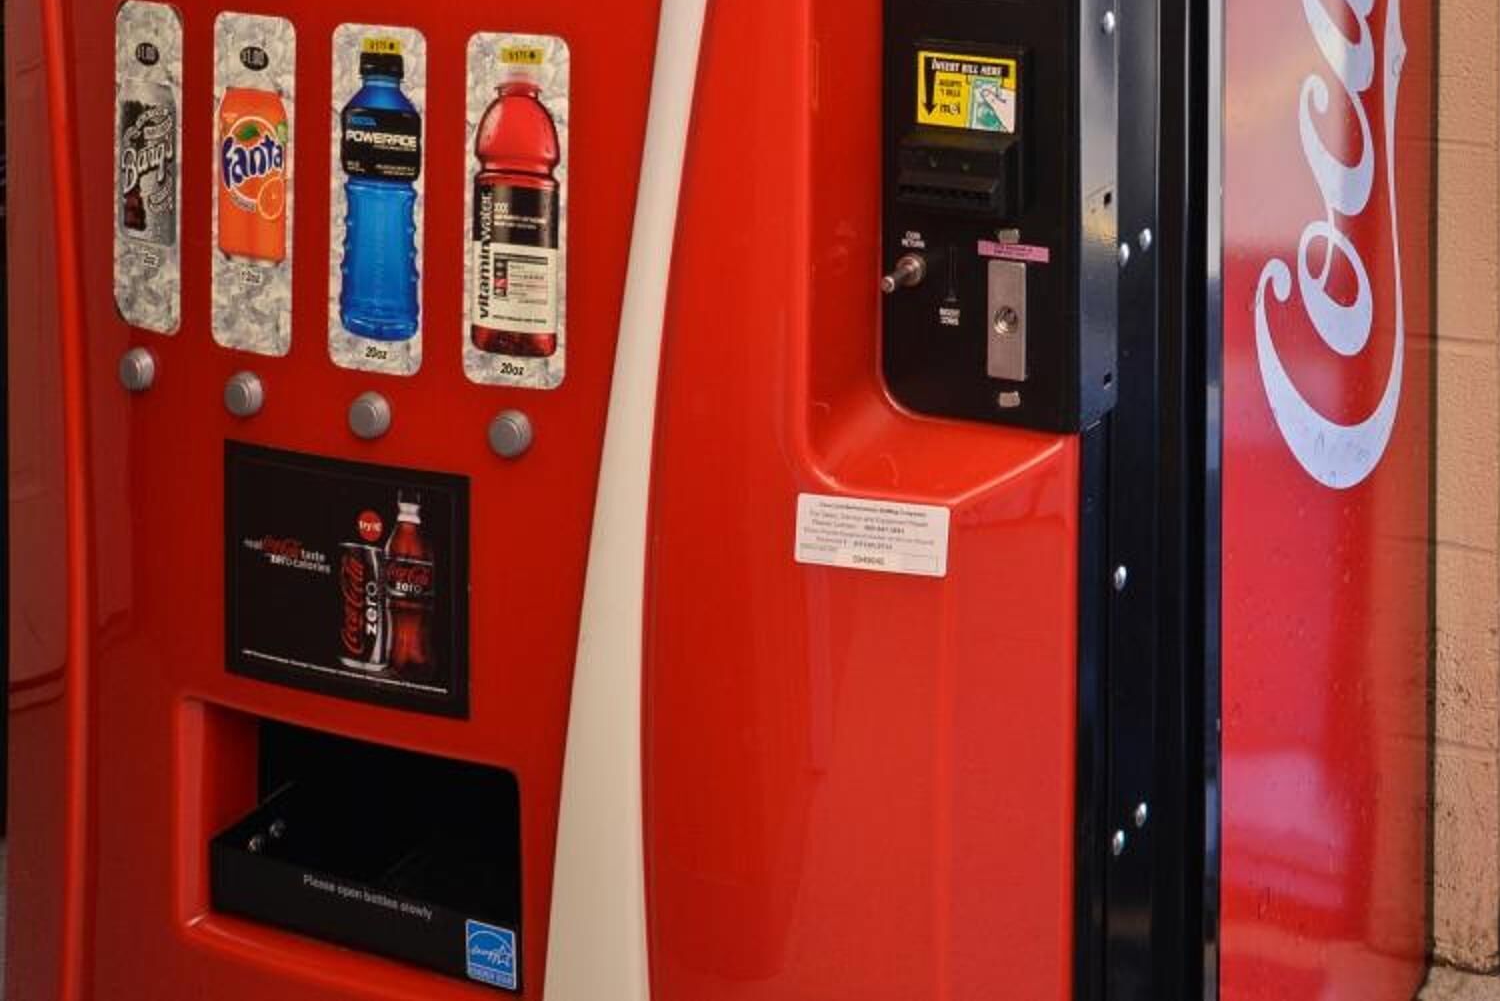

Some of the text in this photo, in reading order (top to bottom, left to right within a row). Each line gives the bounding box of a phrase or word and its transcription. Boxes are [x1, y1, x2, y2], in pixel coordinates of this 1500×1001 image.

[345, 130, 418, 148] POWERADE
[499, 361, 525, 377] 20oz
[395, 581, 422, 593] zero
[365, 581, 379, 636] zero
